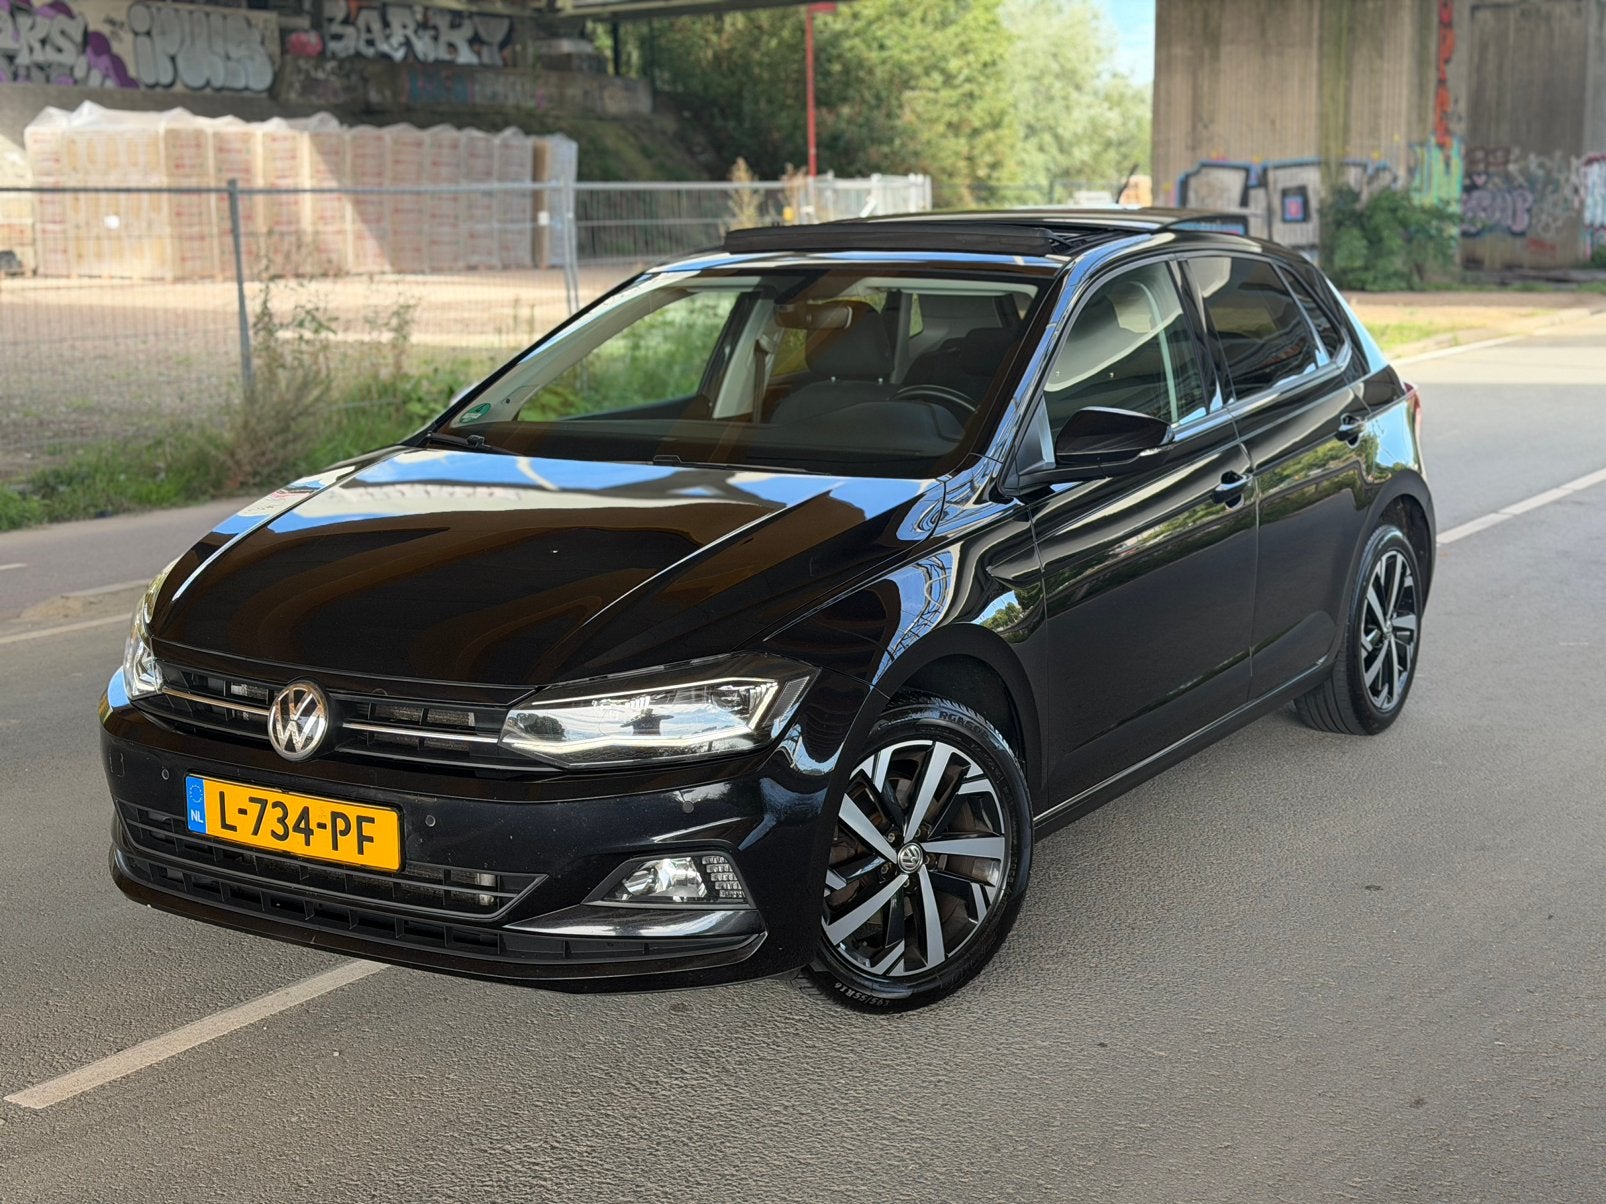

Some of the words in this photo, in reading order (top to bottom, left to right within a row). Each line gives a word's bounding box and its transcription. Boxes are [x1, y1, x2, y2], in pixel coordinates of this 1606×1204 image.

[269, 684, 327, 759] VW
[190, 809, 204, 824] NL
[218, 790, 376, 856] L-734-PF
